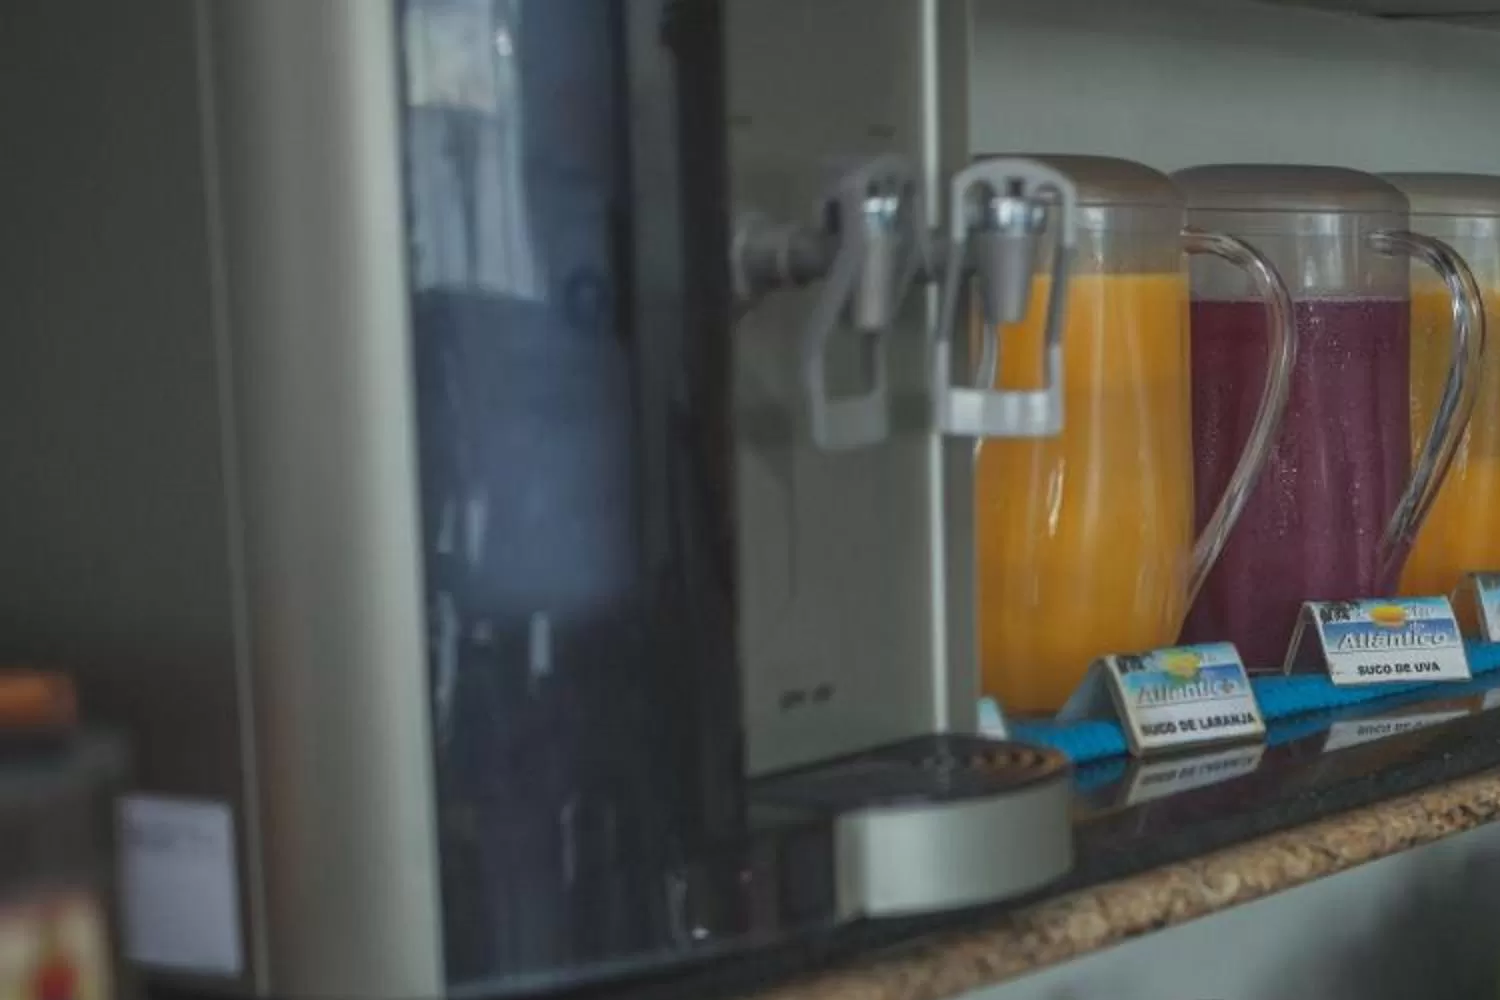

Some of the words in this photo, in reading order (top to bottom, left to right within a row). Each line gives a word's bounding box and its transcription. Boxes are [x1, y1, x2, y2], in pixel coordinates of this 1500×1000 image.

[1339, 630, 1448, 650] Atlântico
[1357, 663, 1392, 676] SUCO
[1394, 662, 1412, 673] DE
[1414, 661, 1441, 673] UVA
[1179, 718, 1198, 733] DE
[1199, 712, 1255, 731] LARANJA
